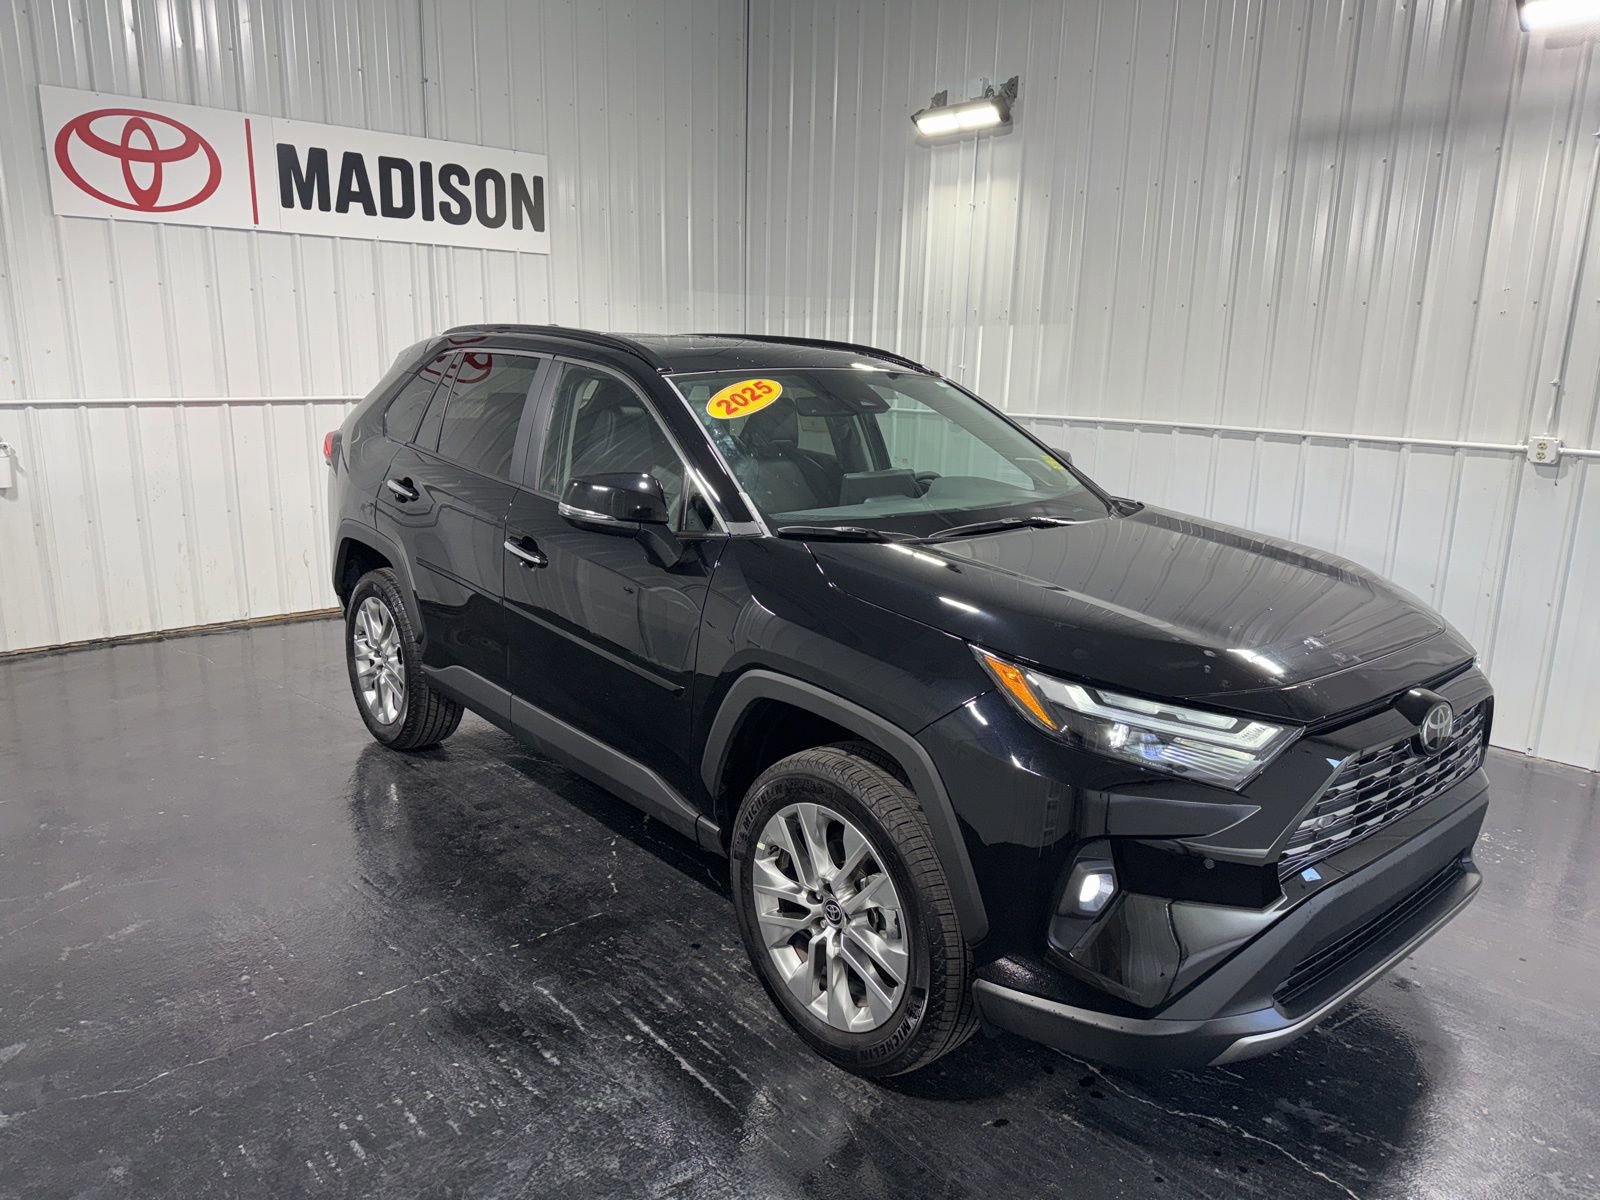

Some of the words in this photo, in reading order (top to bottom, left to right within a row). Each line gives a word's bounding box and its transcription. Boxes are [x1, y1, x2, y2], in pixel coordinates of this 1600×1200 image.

[276, 142, 545, 232] MADISON
[716, 381, 773, 415] 2025
[742, 783, 783, 831] MICHELIN
[860, 1017, 912, 1060] MICHELIN
